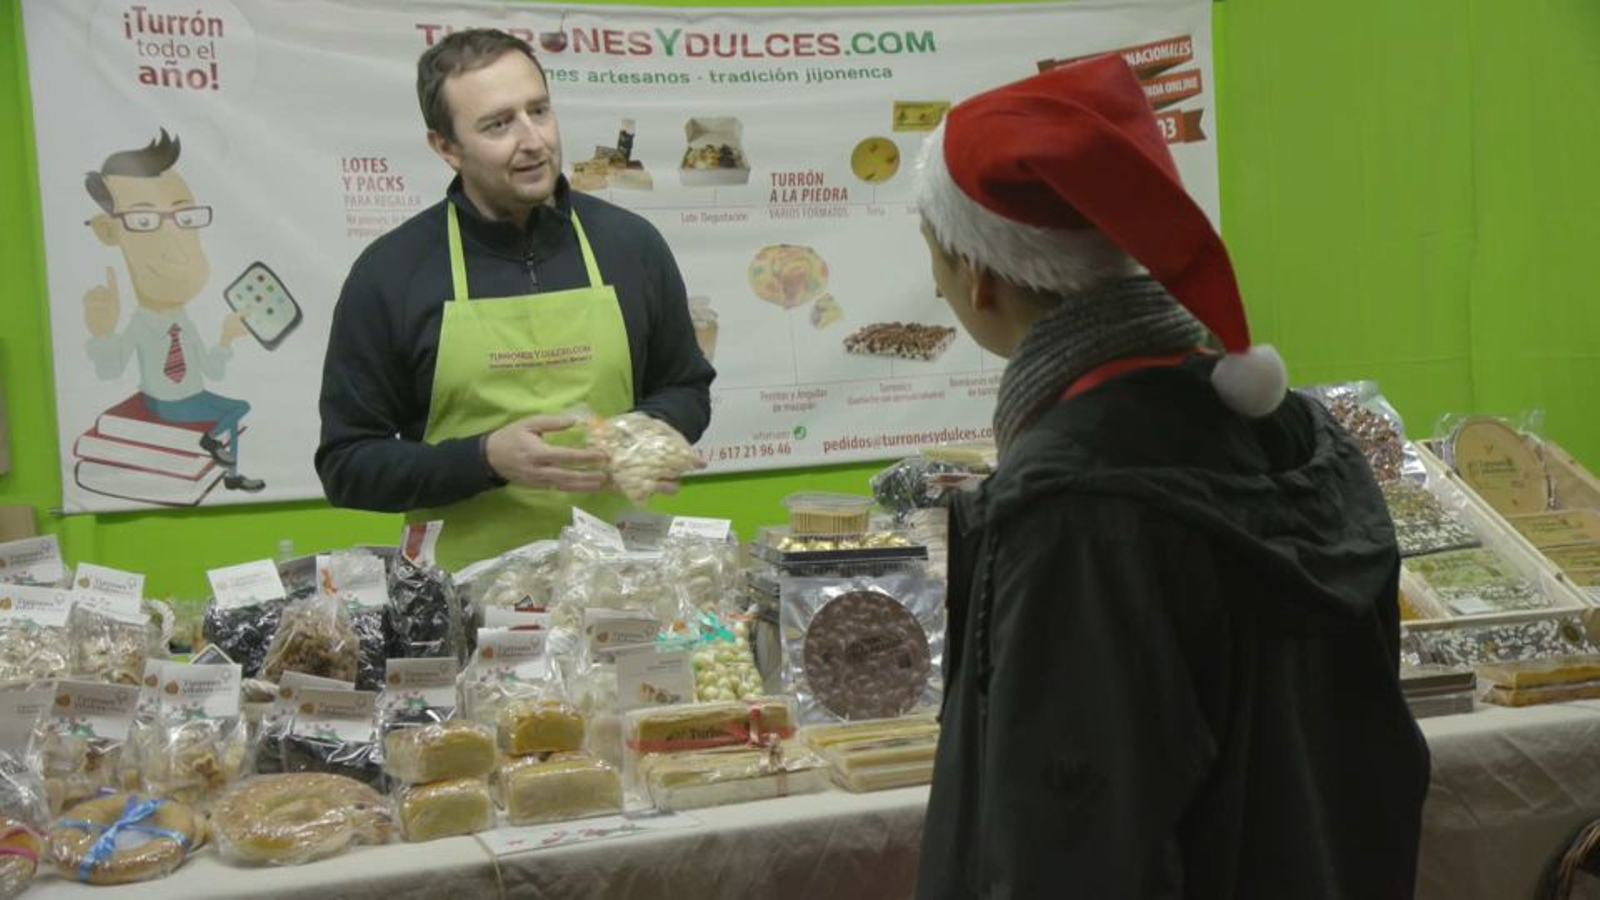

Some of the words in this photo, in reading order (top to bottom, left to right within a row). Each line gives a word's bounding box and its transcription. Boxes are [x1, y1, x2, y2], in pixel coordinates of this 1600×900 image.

[123, 5, 224, 40] ¡Turrón
[137, 39, 191, 59] todo
[196, 40, 216, 60] el
[1125, 40, 1192, 67] NACIONALES
[137, 59, 219, 90] año!
[587, 68, 691, 85] artesanos
[709, 67, 799, 84] tradición
[805, 66, 893, 84] jijonenca
[1165, 76, 1198, 94] ONLINE
[341, 157, 389, 173] LOTES
[342, 175, 352, 192] Y
[357, 176, 406, 192] PACKS
[770, 170, 825, 187] TURRÓN
[769, 189, 778, 203] A
[782, 189, 797, 203] LA
[801, 187, 849, 202] PIEDRA
[768, 206, 801, 219] VARIOS
[802, 205, 849, 218] FORMATOS
[719, 445, 740, 460] 617
[744, 443, 757, 459] 21
[760, 442, 774, 456] 96
[777, 440, 792, 455] 46
